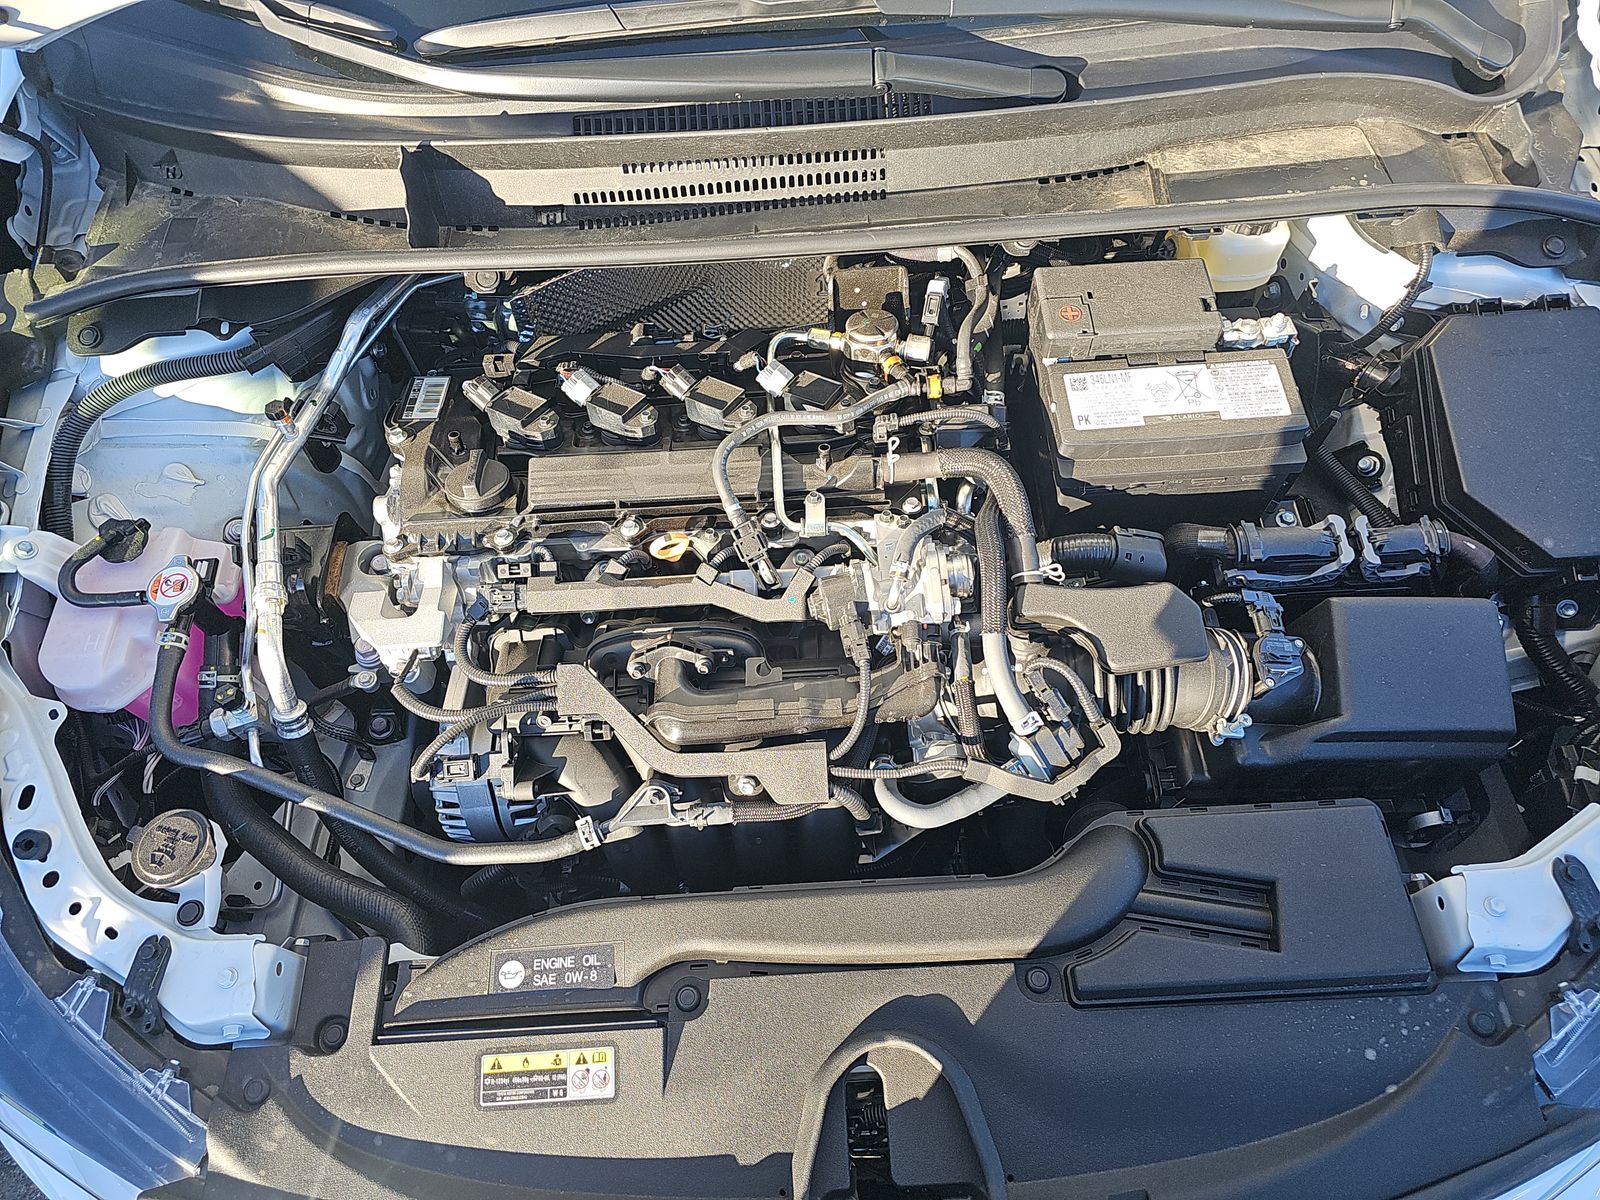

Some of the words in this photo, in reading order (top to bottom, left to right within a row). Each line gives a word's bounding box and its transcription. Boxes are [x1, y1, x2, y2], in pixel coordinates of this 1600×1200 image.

[1089, 371, 1132, 386] 345LN1-MF
[1077, 414, 1092, 426] PK
[533, 955, 576, 971] ENGINE
[582, 953, 602, 967] OIL
[532, 973, 557, 986] SAE
[564, 969, 598, 984] 0W-8
